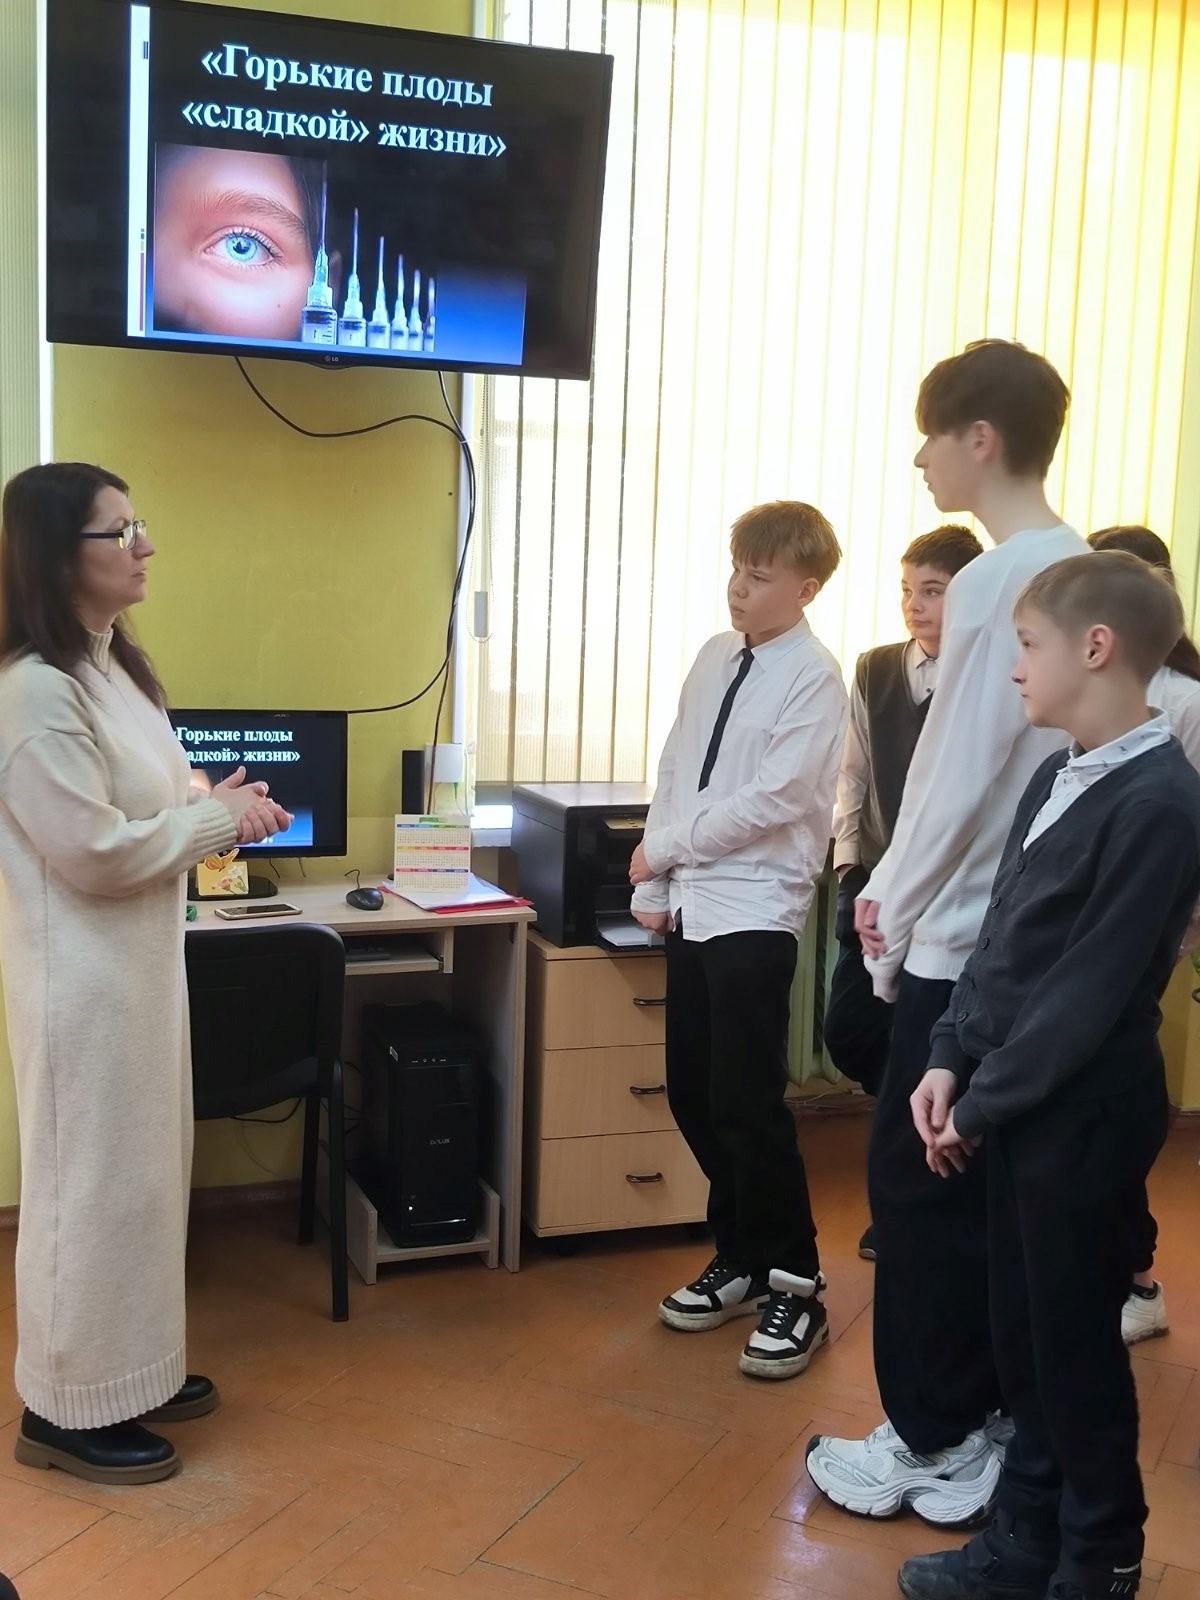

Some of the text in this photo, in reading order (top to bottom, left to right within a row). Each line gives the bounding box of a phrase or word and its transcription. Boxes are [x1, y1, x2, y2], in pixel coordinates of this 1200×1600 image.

[201, 43, 493, 108] «Горькие плоды
[181, 101, 508, 158] «сладкой» жизни»
[244, 730, 293, 743] плоды
[186, 748, 300, 763] адкой» жизни»
